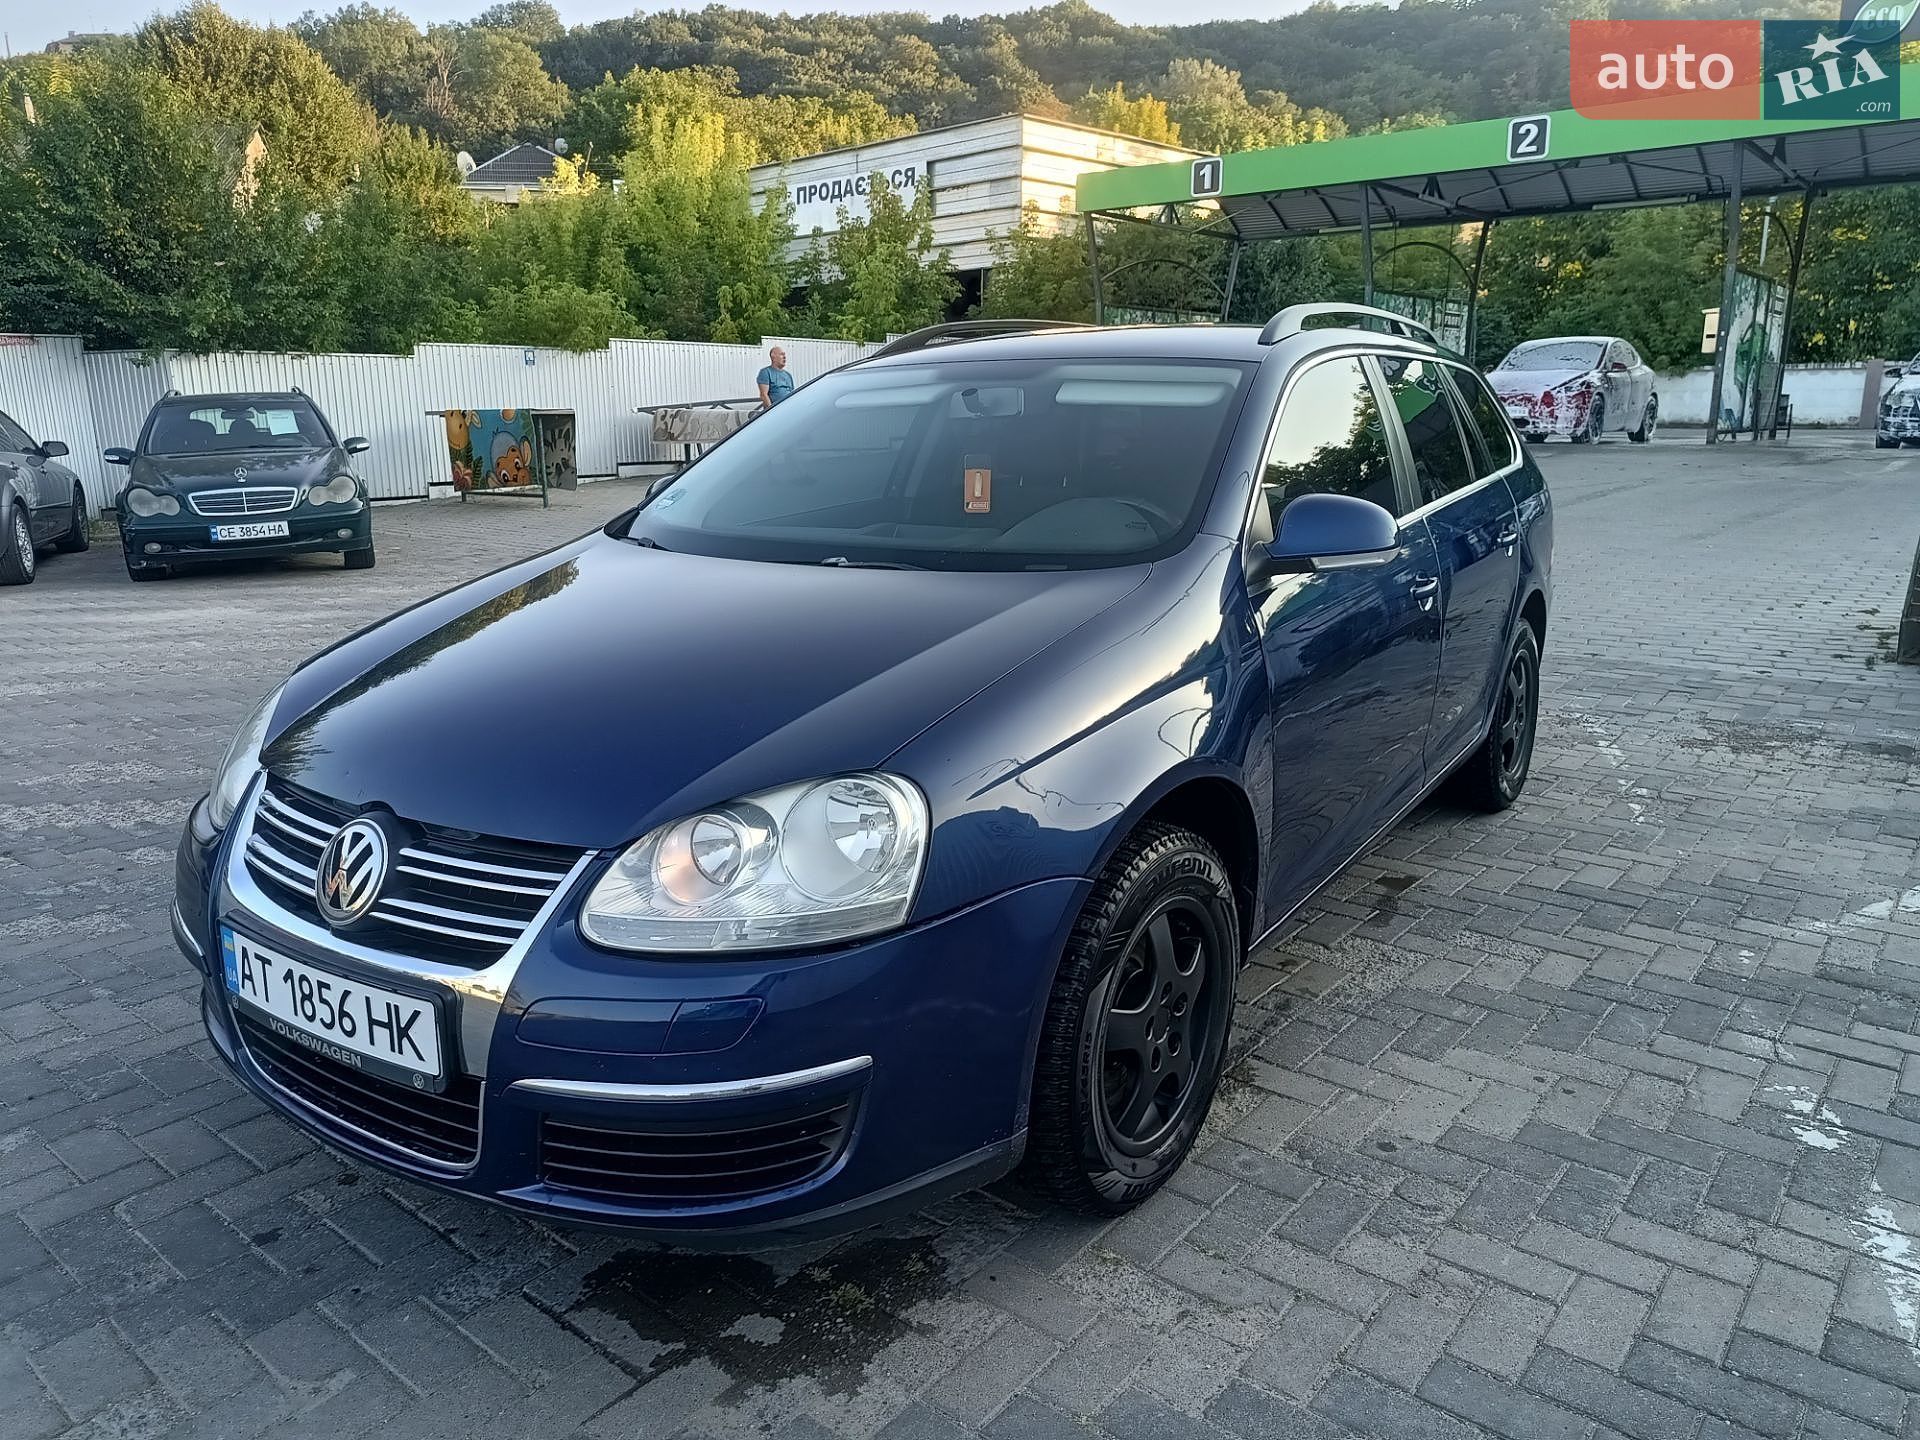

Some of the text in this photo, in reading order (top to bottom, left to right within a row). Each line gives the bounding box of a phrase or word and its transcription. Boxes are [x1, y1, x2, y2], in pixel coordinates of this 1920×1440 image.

[1516, 124, 1539, 154] 2
[796, 166, 917, 206] ПРОДАЄСЯ
[1199, 164, 1212, 190] 1
[219, 523, 285, 539] CE 3854 HA
[225, 966, 239, 985] UA
[241, 946, 426, 1062] AT 1856 HK
[269, 1018, 362, 1069] VOLKSWAGEN
